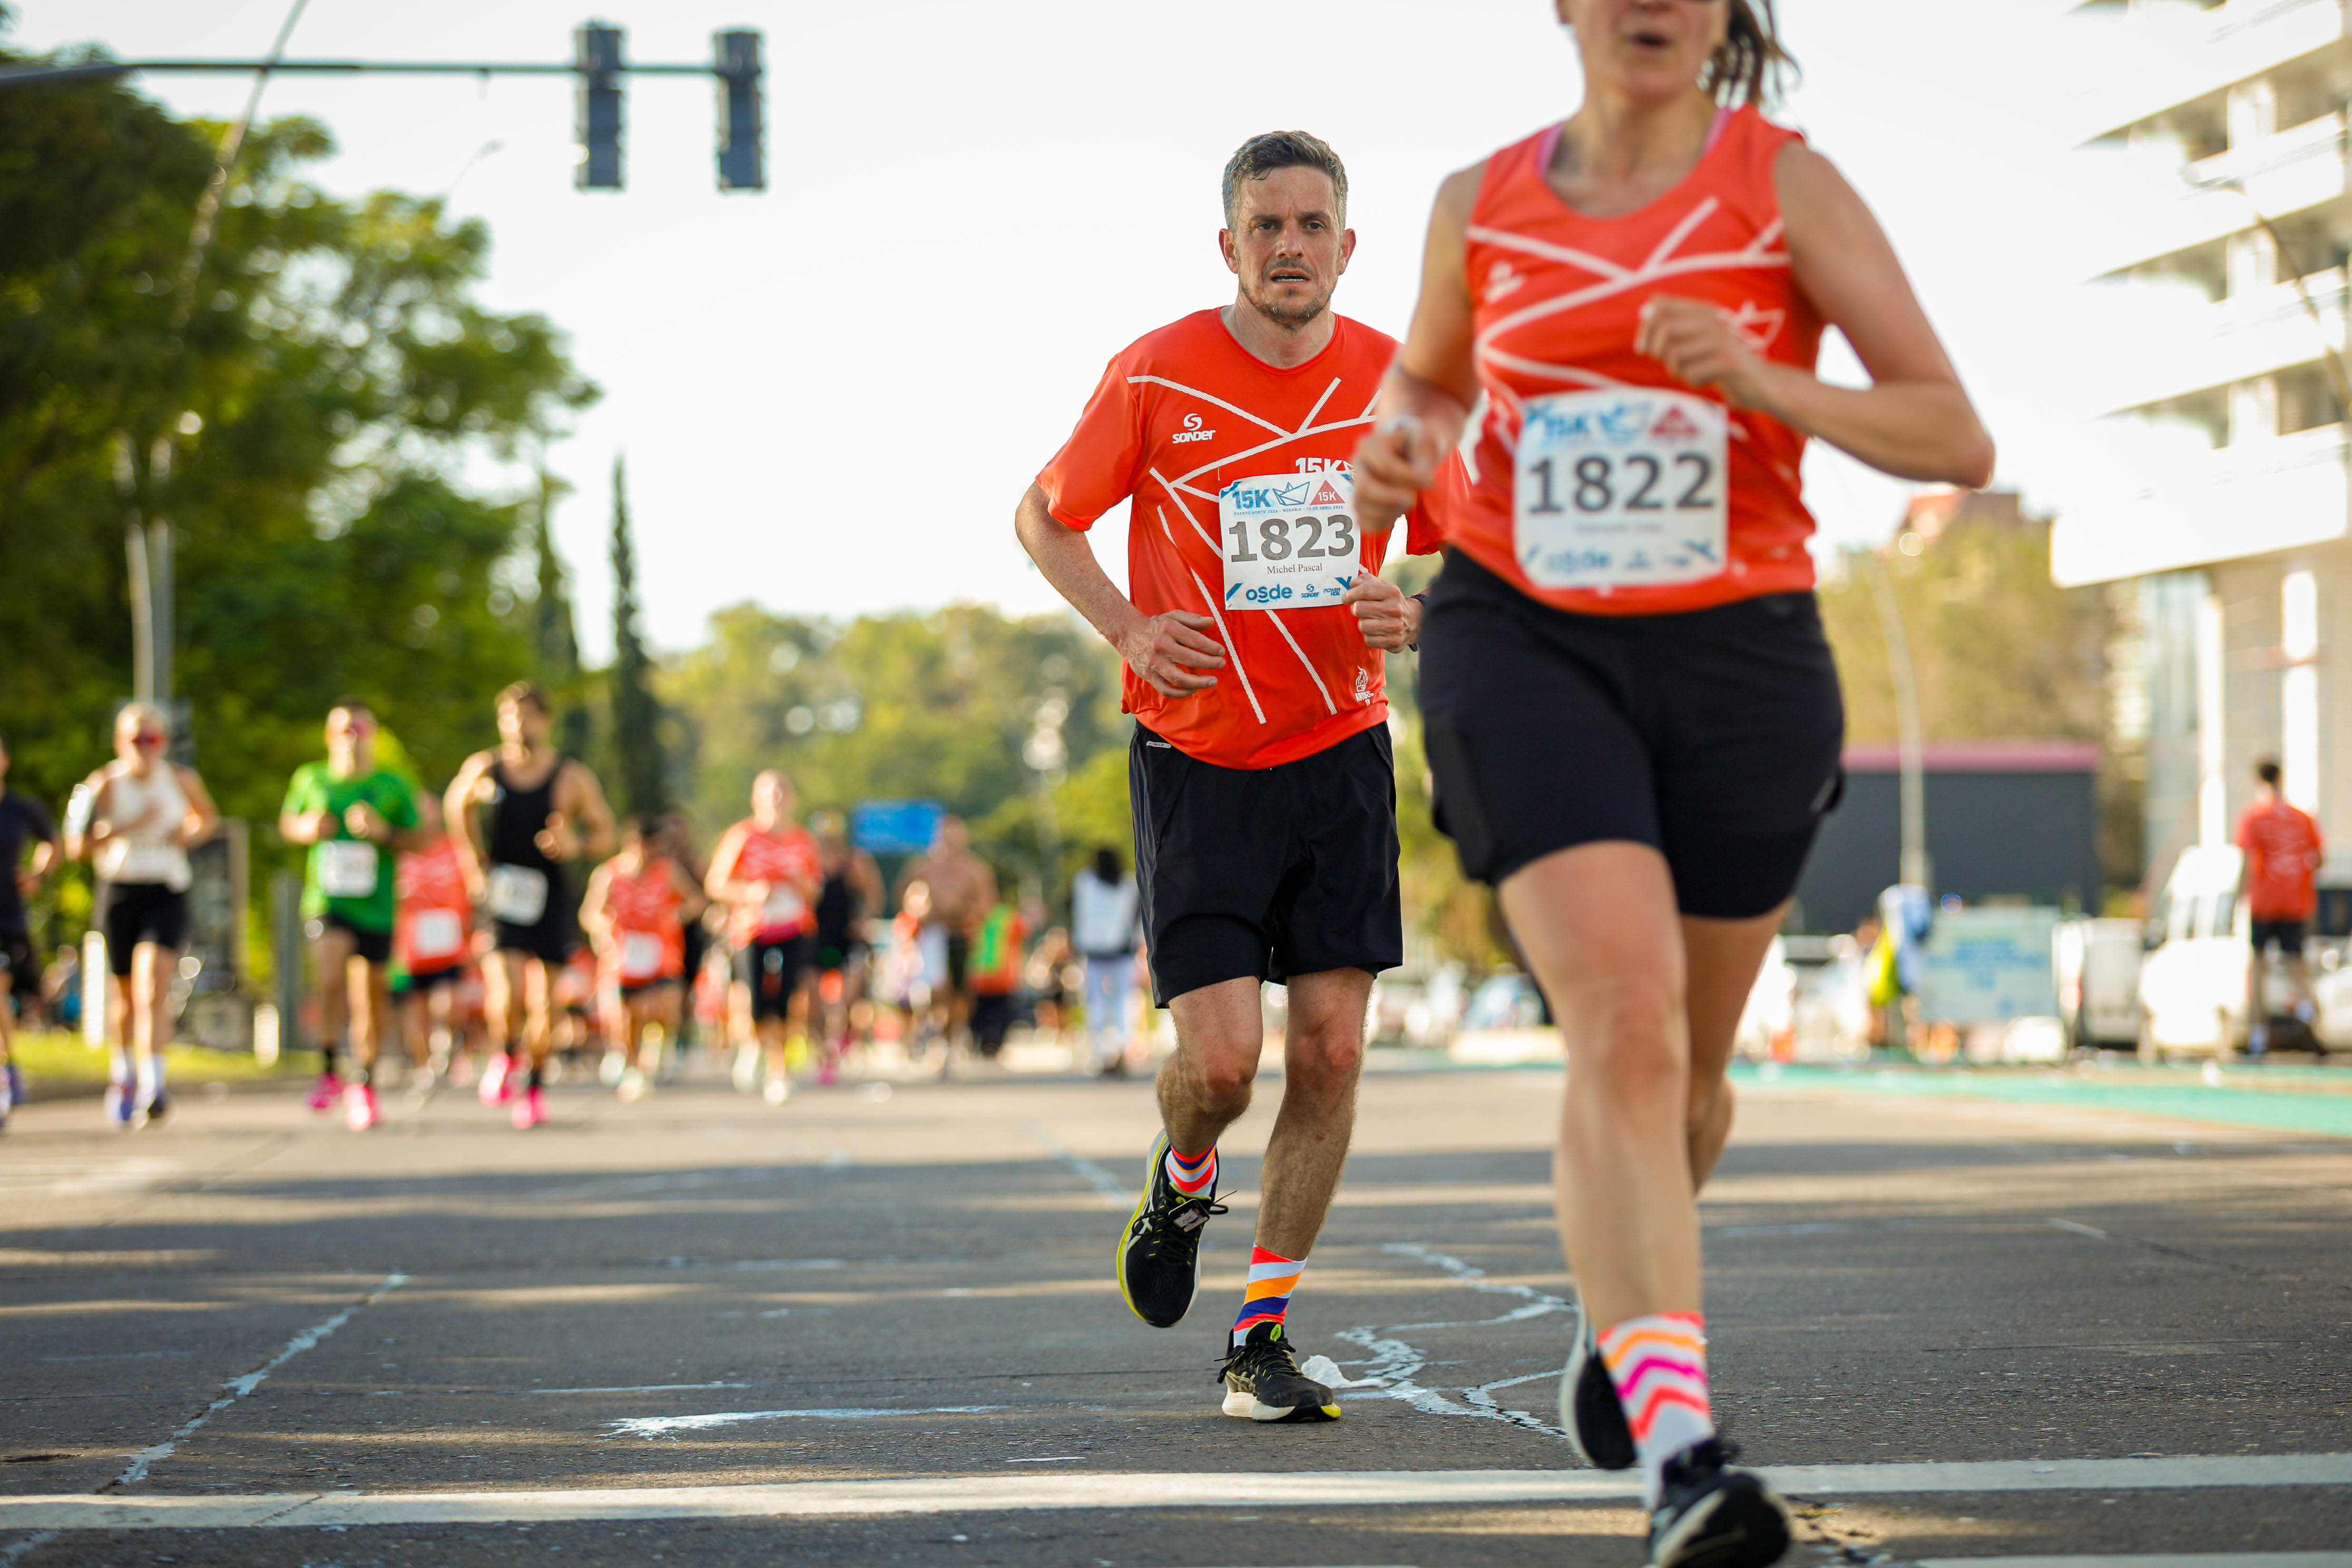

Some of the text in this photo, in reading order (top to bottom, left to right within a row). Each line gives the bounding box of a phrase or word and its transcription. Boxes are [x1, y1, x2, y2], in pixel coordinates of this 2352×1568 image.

[1528, 452, 1715, 515] 1822
[1232, 489, 1271, 509] 15K
[1317, 491, 1337, 502] 15K
[1229, 514, 1354, 562] 1823
[1267, 563, 1322, 574] Michel Pascal
[1246, 583, 1292, 601] osde
